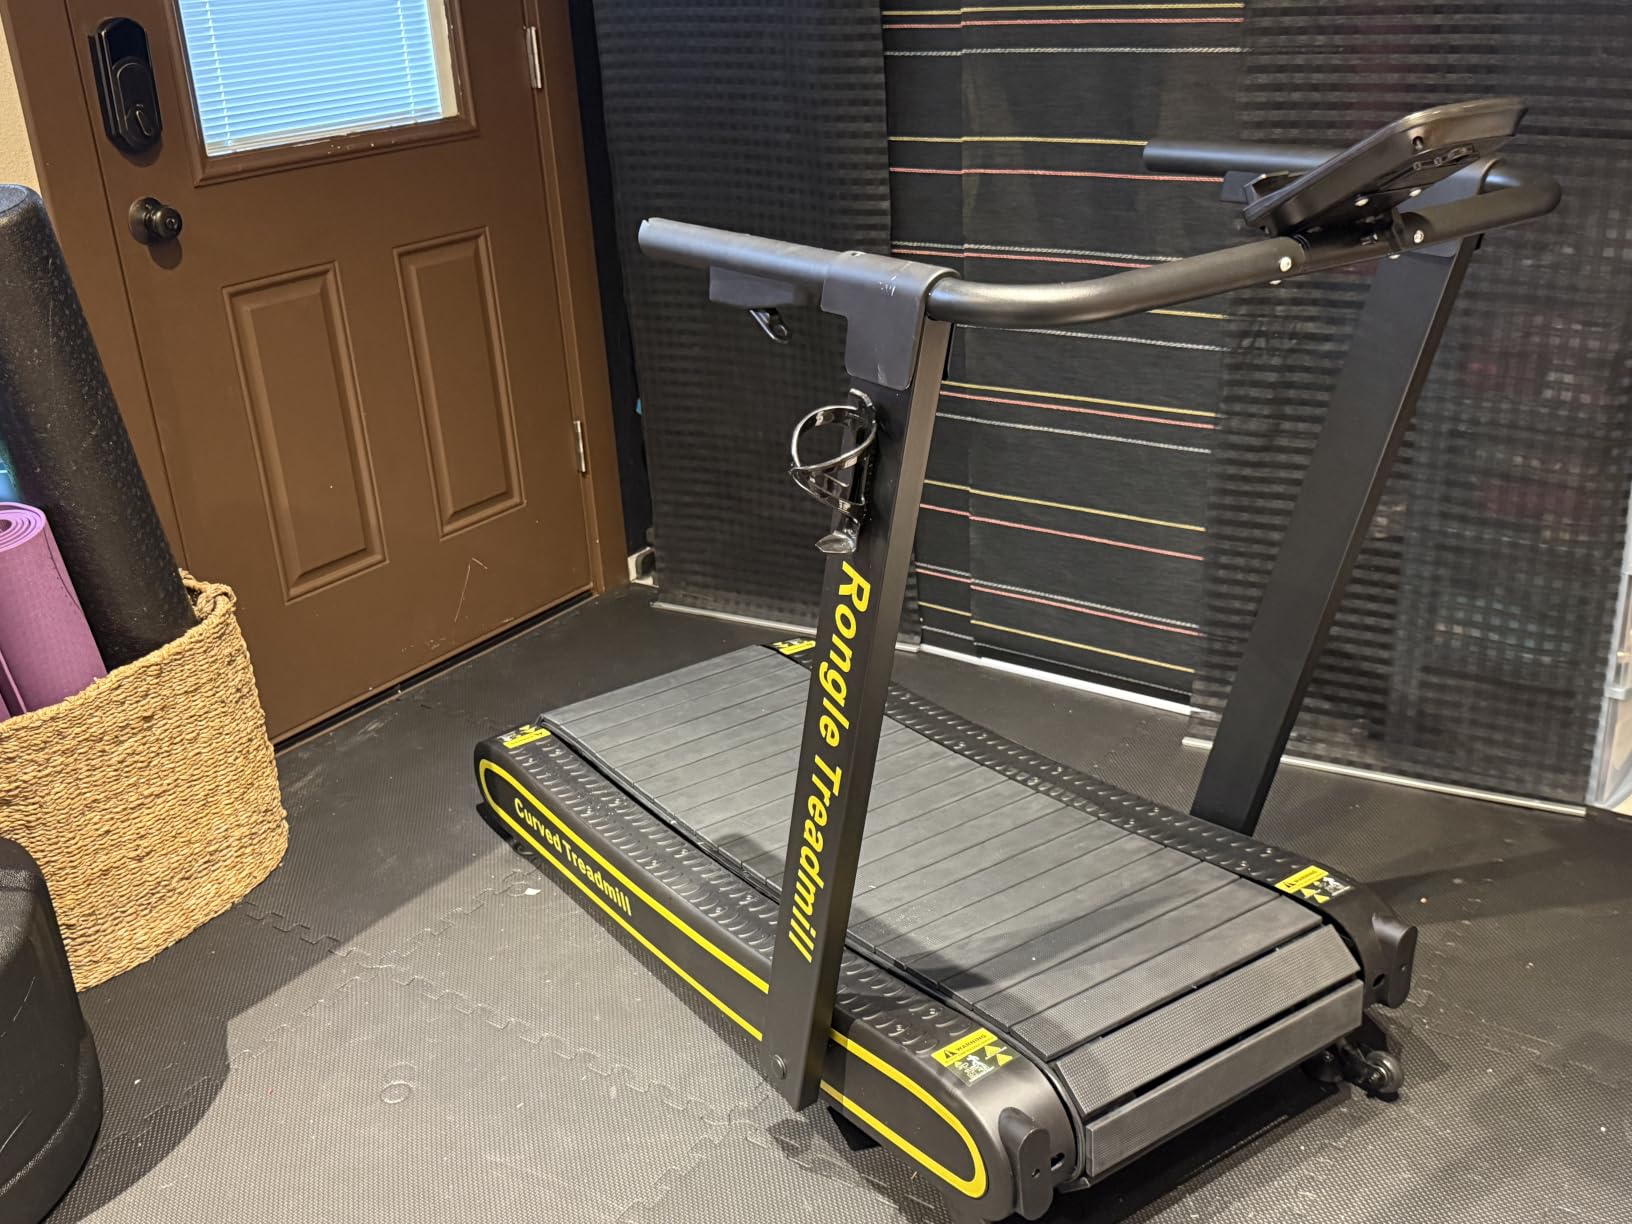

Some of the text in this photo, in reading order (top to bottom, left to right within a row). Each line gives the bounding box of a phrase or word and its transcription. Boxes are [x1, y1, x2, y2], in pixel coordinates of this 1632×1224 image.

[789, 561, 871, 963] Rongle Treadmill
[514, 798, 632, 917] Curved Treadmill
[955, 1033, 987, 1052] WARNING
